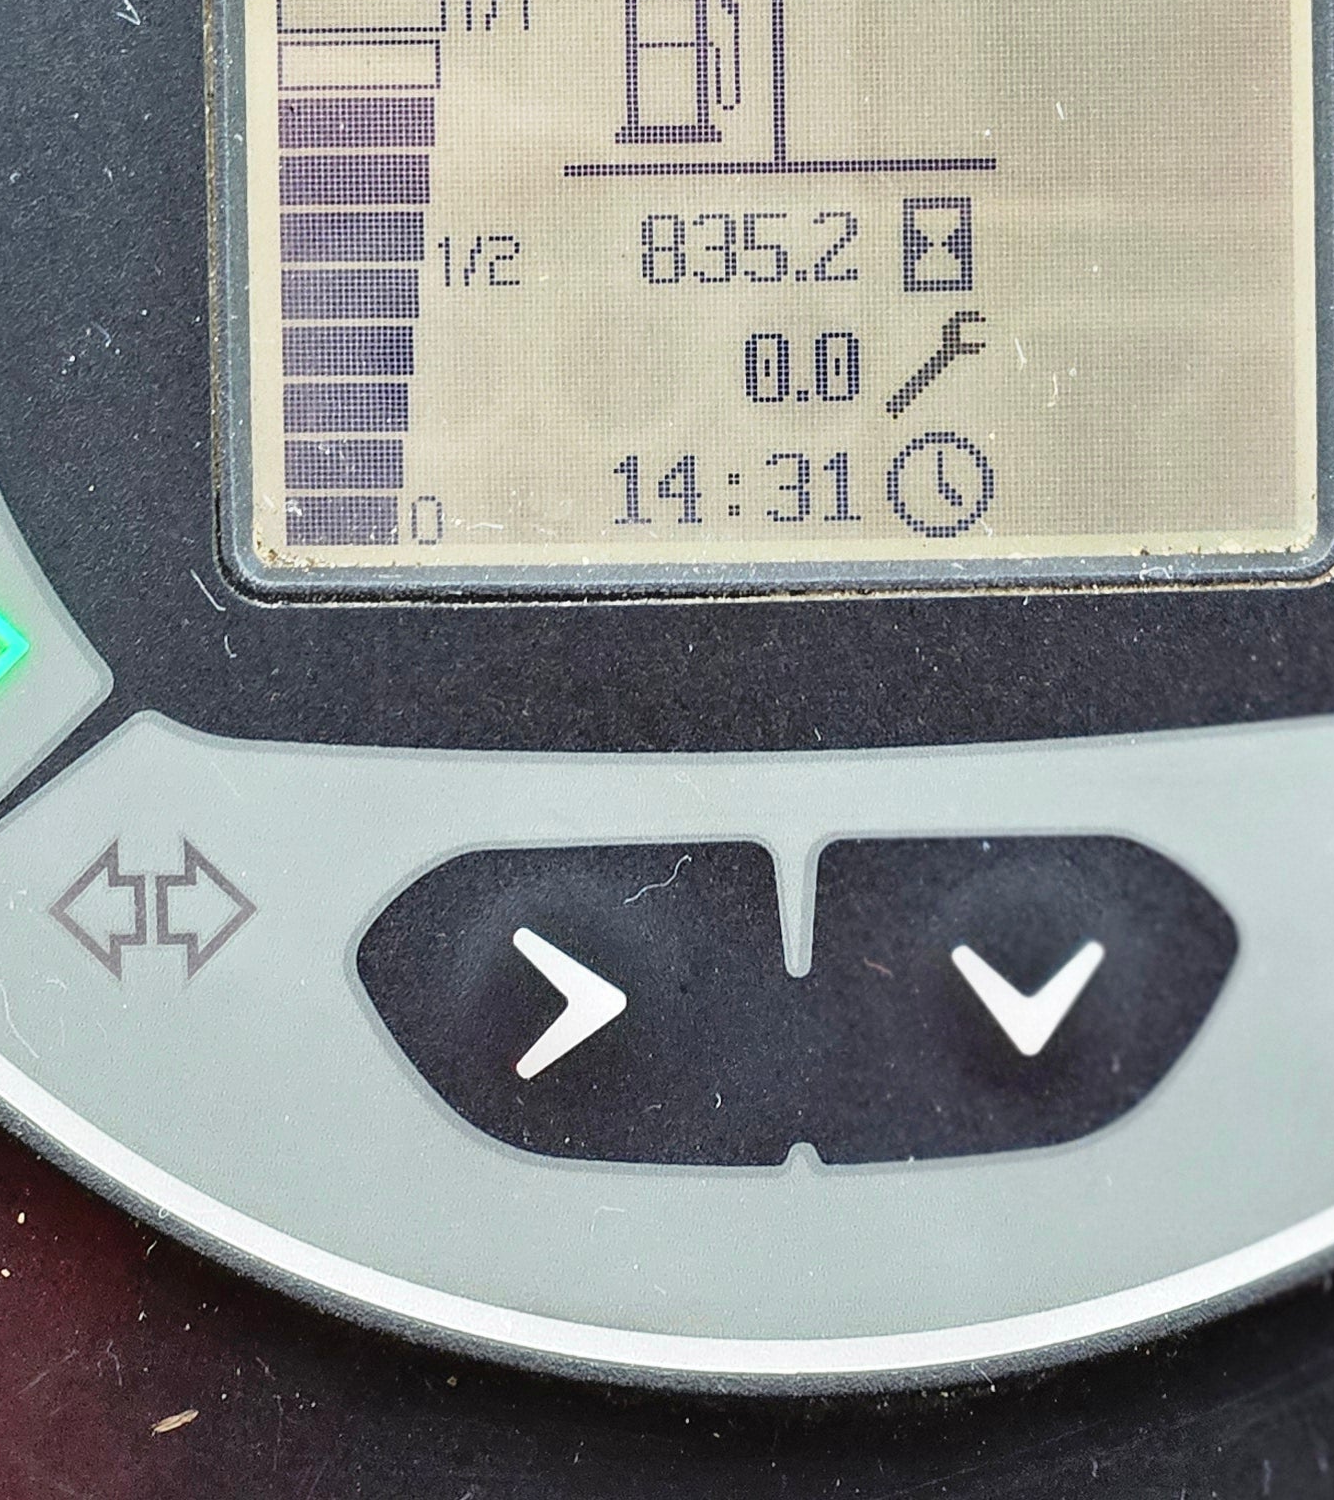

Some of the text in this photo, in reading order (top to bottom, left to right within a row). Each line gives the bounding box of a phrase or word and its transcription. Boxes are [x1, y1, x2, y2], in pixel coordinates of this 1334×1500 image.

[437, 236, 522, 287] 1/2
[638, 211, 861, 286] 835.2
[743, 331, 862, 404] 0.0
[410, 495, 443, 545] 0
[613, 451, 862, 525] 14:31
